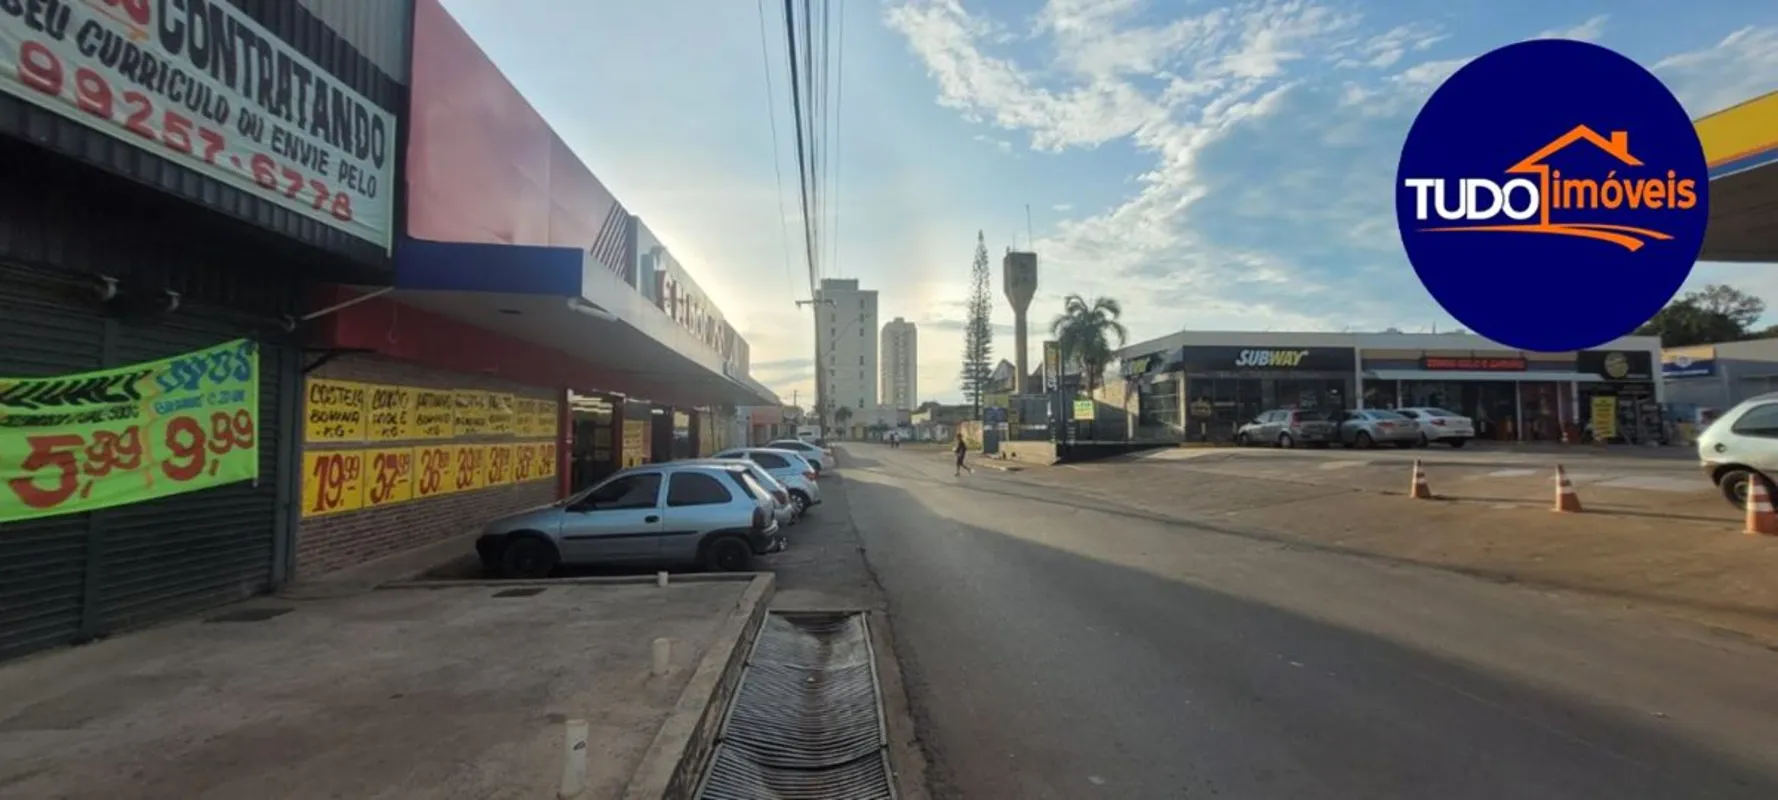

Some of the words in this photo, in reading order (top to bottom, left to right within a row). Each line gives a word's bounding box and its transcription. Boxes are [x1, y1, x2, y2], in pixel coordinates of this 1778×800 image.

[158, 0, 386, 170] CONTRATANDO
[237, 108, 264, 142] OU
[271, 128, 329, 175] ENVIE
[338, 161, 377, 199] PELO
[1235, 349, 1309, 366] SUBWAY
[8, 425, 142, 509] 5,99
[162, 408, 255, 482] 9,99
